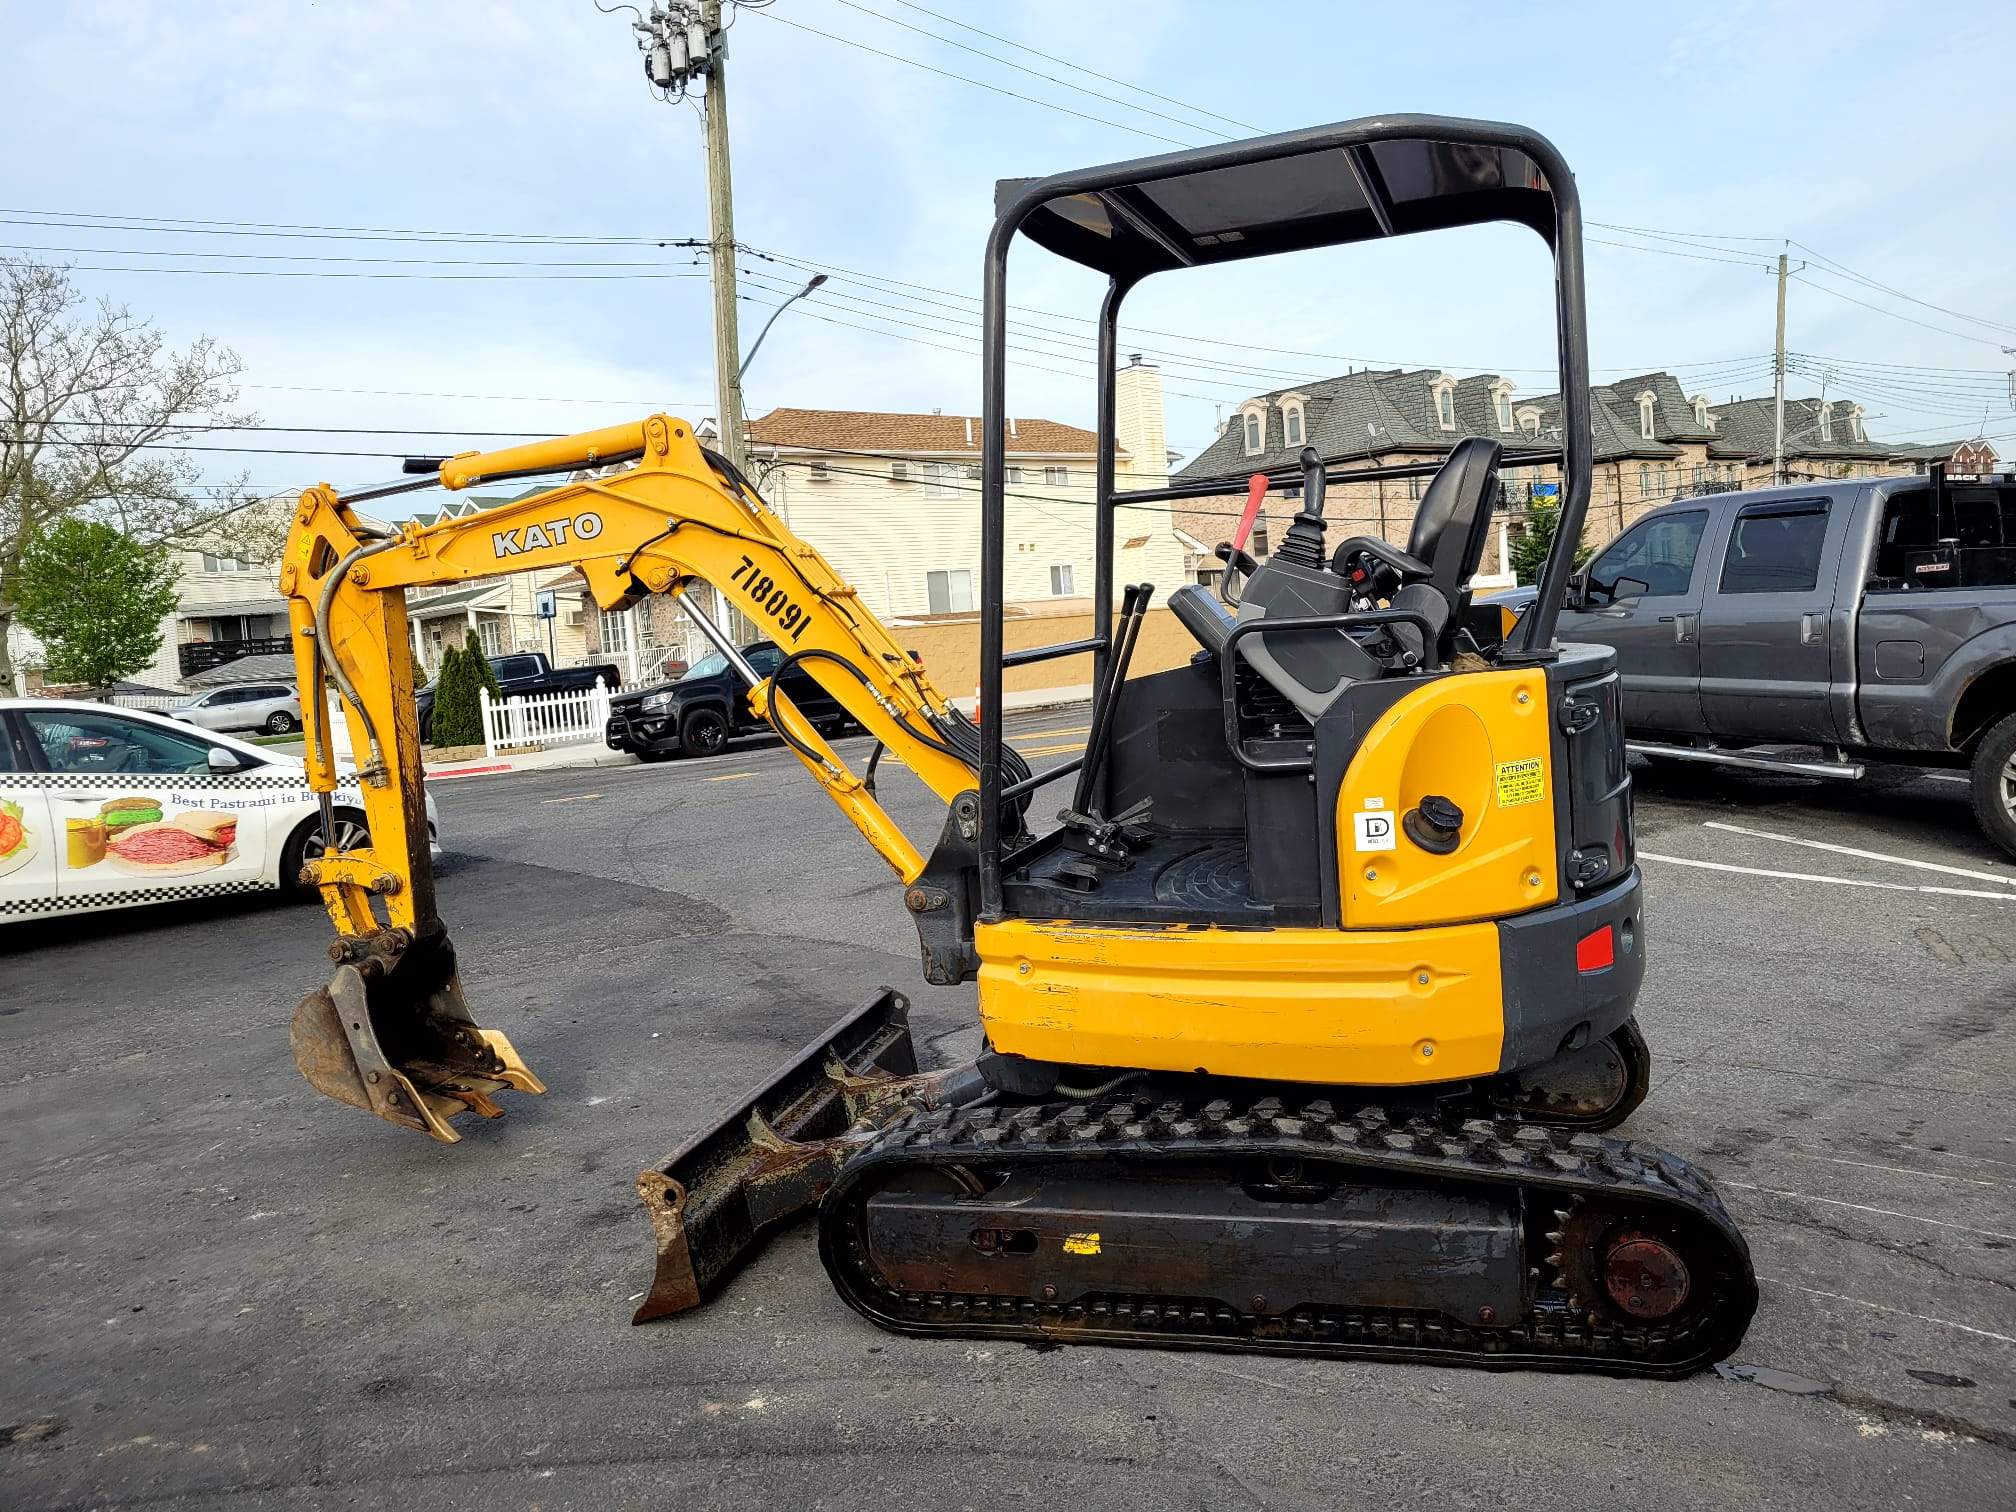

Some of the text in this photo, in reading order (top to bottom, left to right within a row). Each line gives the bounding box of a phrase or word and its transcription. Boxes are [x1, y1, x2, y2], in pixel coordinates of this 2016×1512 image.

[491, 511, 604, 559] KATO
[731, 555, 812, 641] 718091
[1501, 761, 1540, 774] ATTENTION
[171, 791, 362, 808] Best Pastrami in Brklyn
